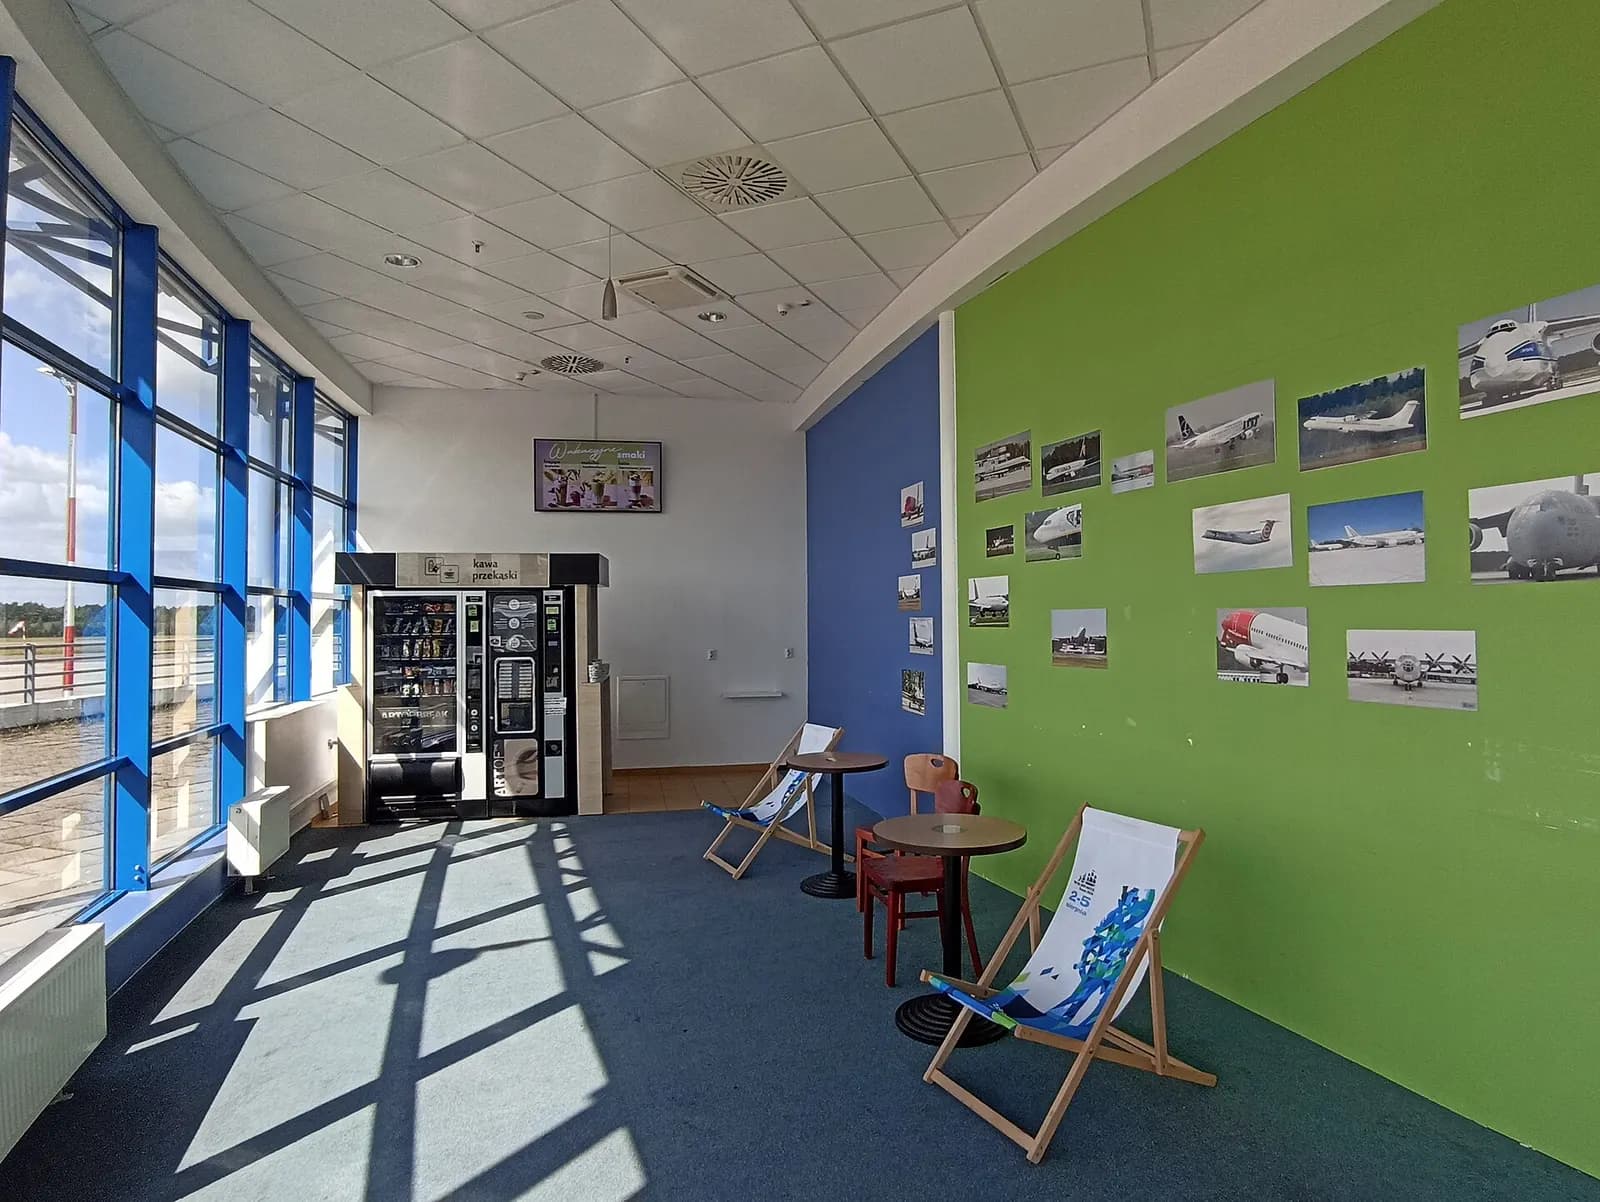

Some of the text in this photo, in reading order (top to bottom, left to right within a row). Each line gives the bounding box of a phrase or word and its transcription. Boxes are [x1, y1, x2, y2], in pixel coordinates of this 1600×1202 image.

[617, 450, 646, 460] smaki
[473, 559, 498, 568] kawa
[472, 570, 518, 583] przekąski
